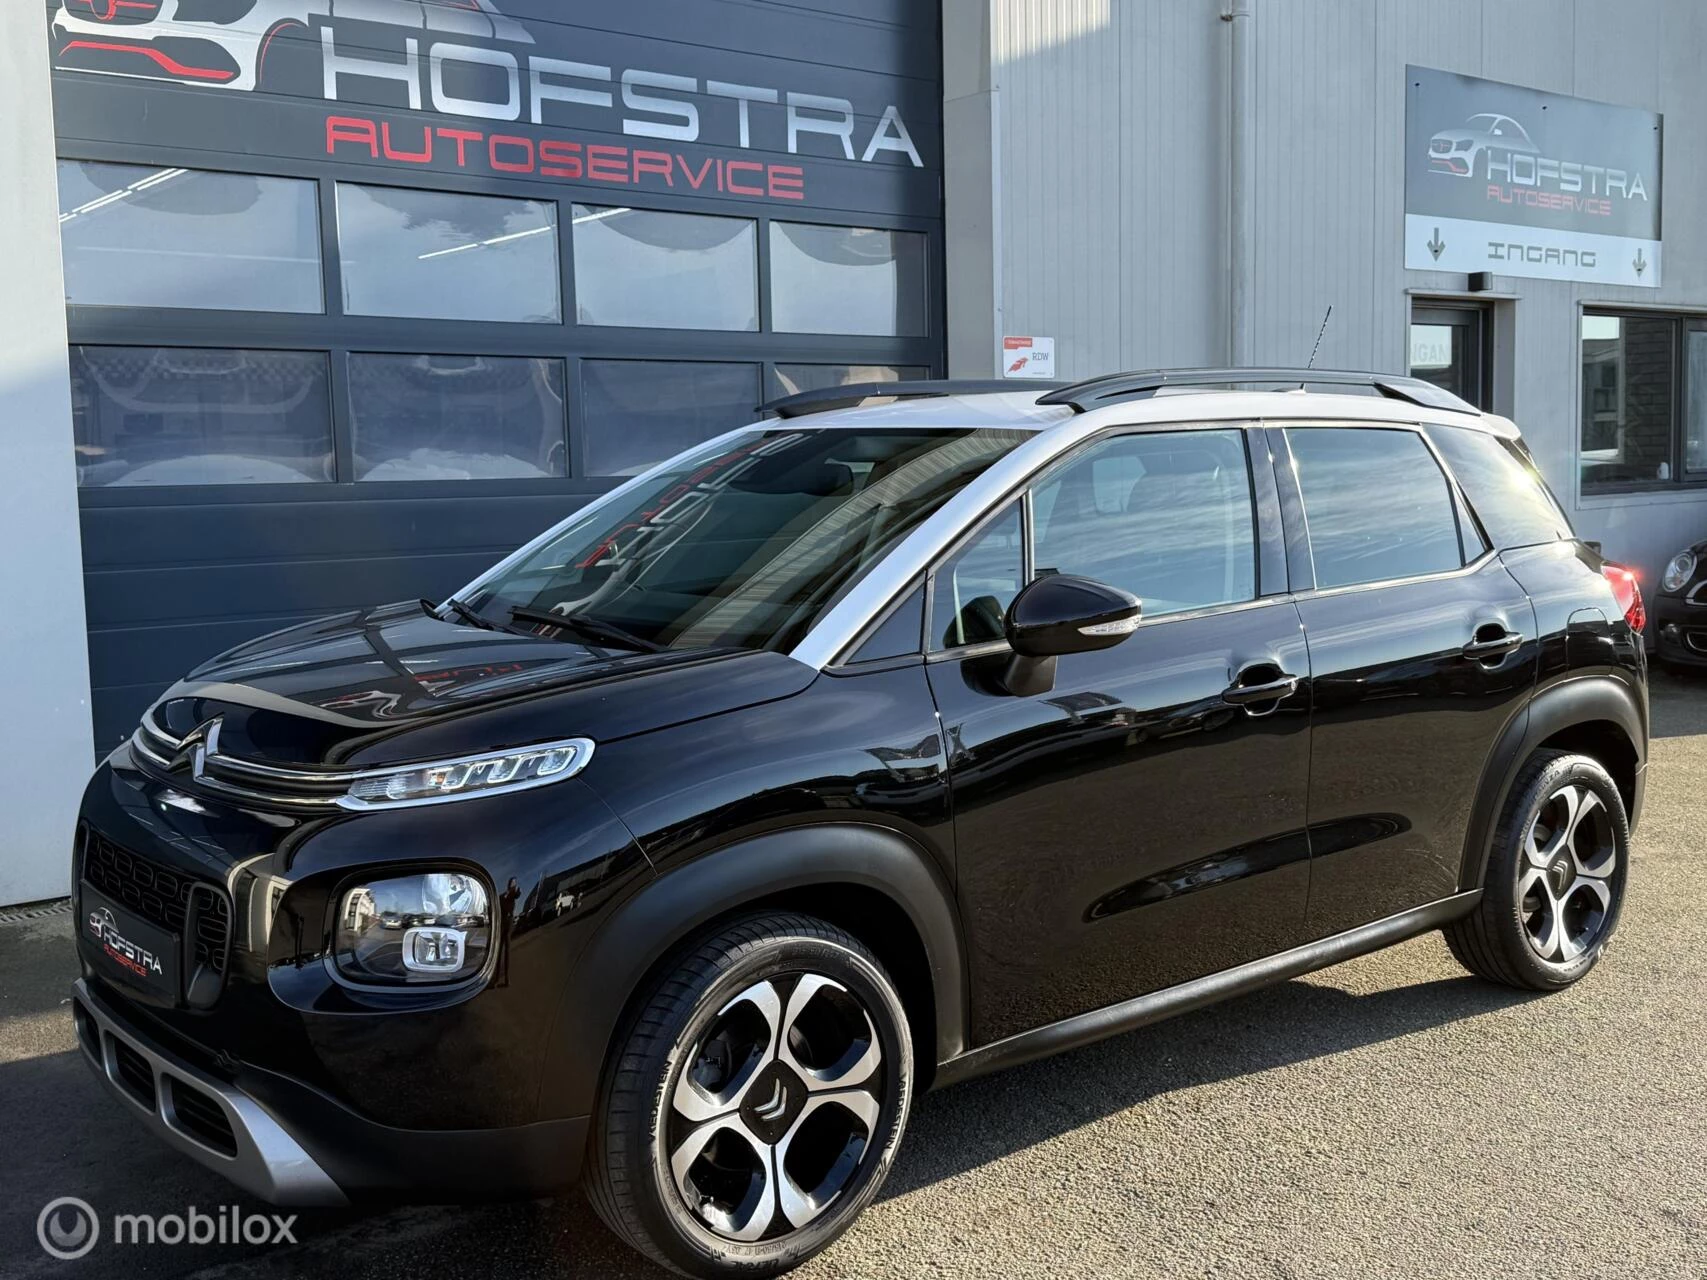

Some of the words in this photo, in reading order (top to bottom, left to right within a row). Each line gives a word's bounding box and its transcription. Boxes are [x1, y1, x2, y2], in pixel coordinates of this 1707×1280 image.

[320, 25, 924, 168] HOFSTRA
[325, 115, 804, 200] AUTOSERVICE
[1487, 149, 1648, 201] HOFSTRA
[1487, 184, 1612, 216] AUTOSERVICE
[1488, 241, 1597, 268] INGANG
[1032, 352, 1049, 361] RDW
[103, 925, 163, 975] HOFSTRA
[885, 1071, 907, 1150] VREDESTEIN
